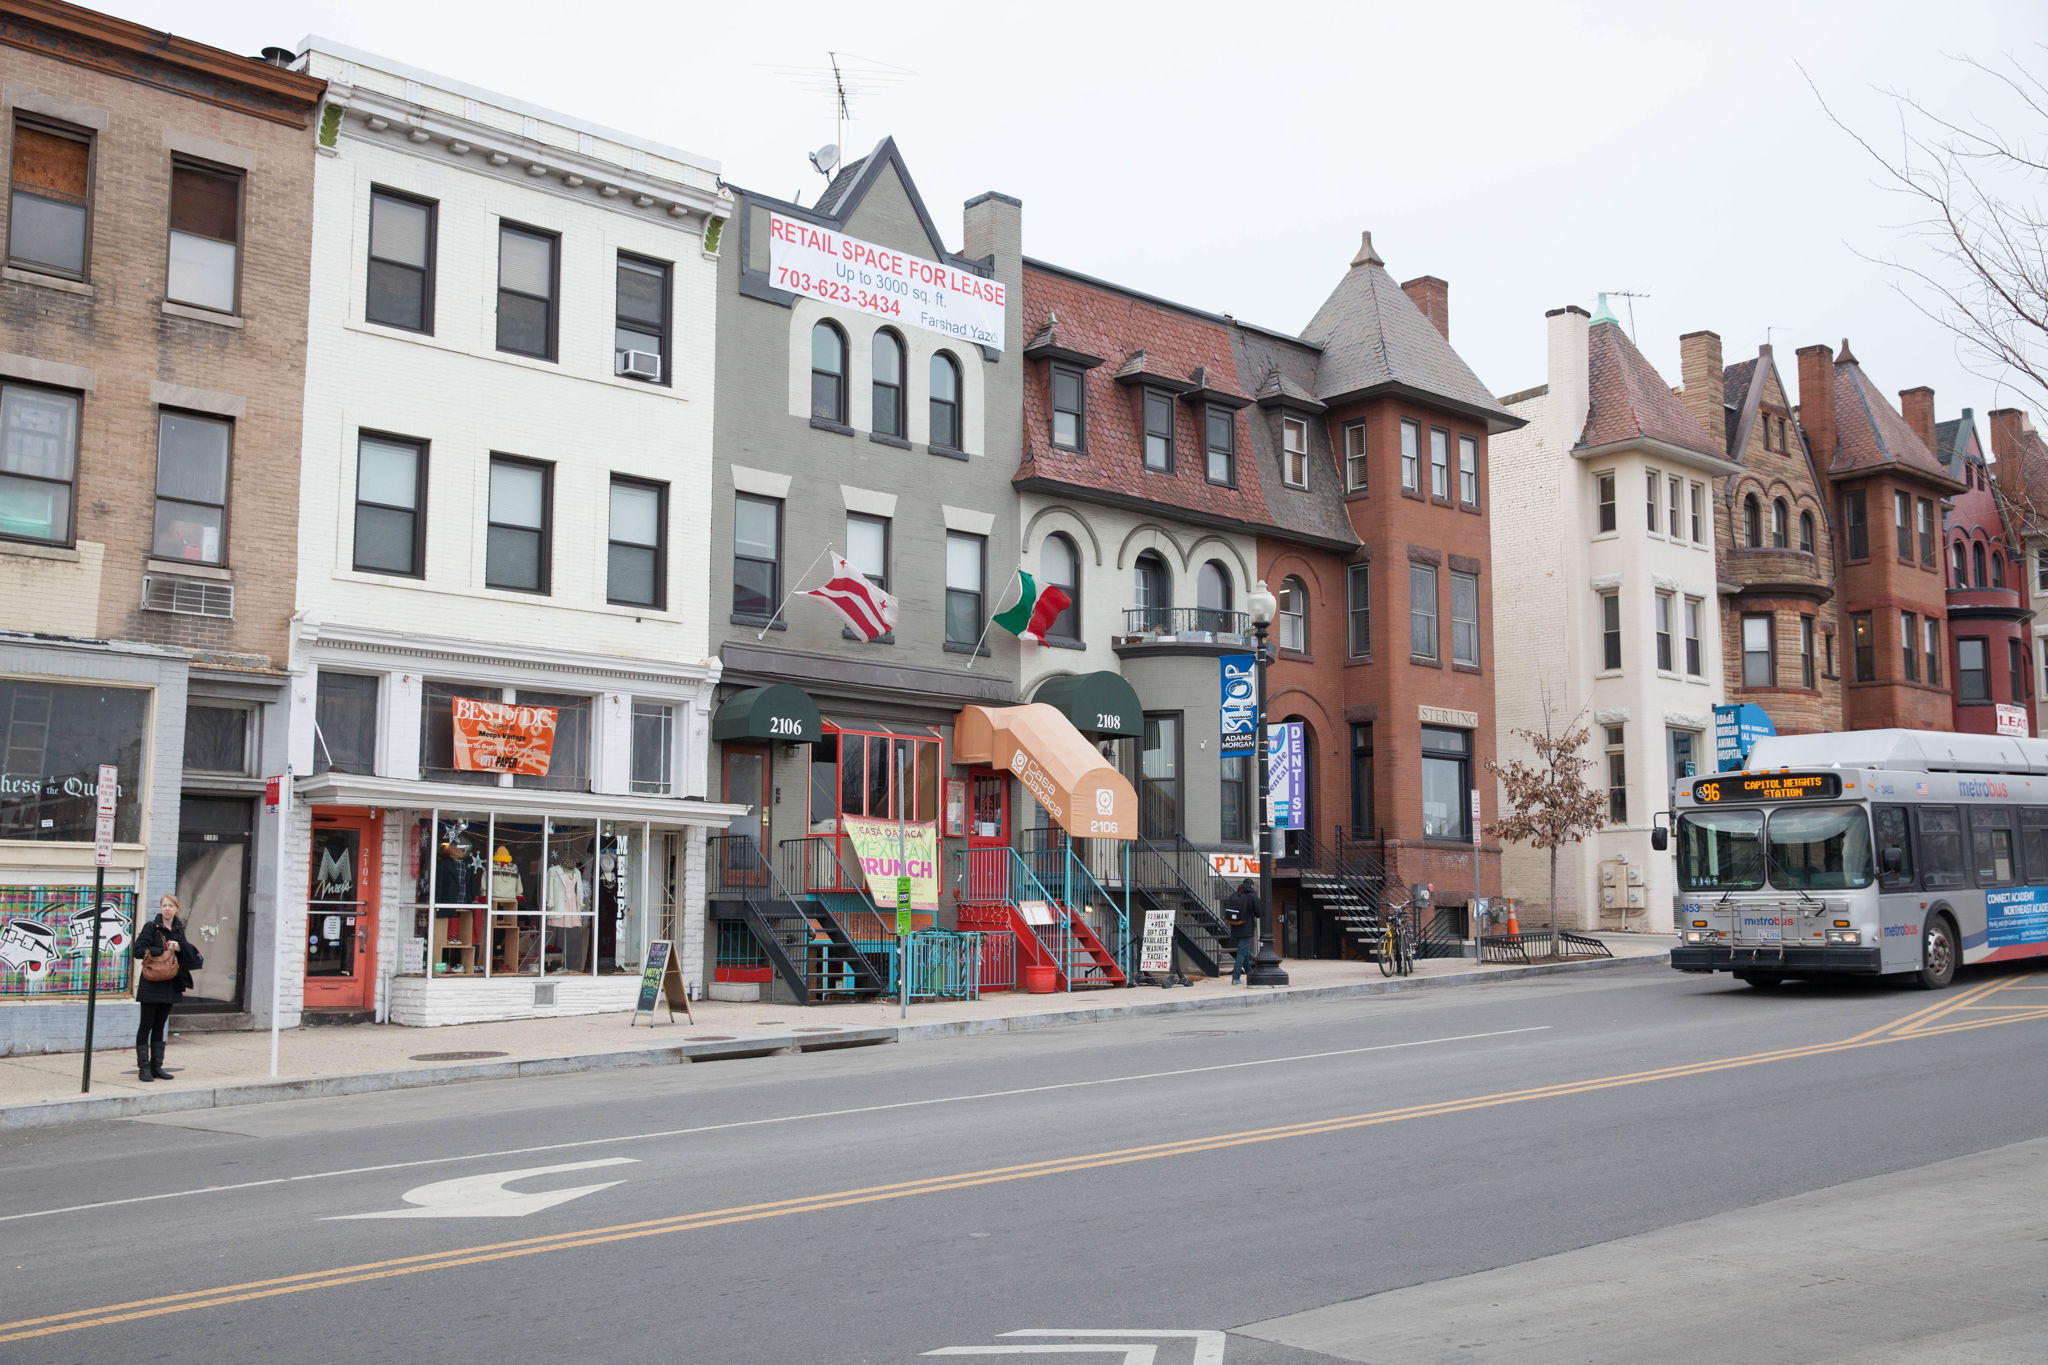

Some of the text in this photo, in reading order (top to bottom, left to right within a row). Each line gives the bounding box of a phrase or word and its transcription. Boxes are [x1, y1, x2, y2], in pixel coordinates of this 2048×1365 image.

[771, 218, 1005, 306] RETAIL SPACE FOR LEASE
[778, 266, 901, 316] 703-623-3434
[836, 262, 947, 308] Up to 3000 sq. ft.
[921, 311, 966, 336] Farshad
[1225, 664, 1253, 732] SHOP
[455, 699, 506, 723] BEST
[505, 706, 520, 725] of
[1096, 713, 1121, 729] 2108
[1421, 707, 1476, 726] STERLING
[770, 716, 802, 735] 2106
[1716, 725, 1739, 736] MORGAN
[478, 730, 526, 742] Meeps Vintage
[1222, 741, 1254, 749] MORGAN
[1225, 734, 1252, 742] ADAMS
[1717, 737, 1738, 748] ANIMAL
[1718, 748, 1743, 760] HOSPITAL
[1268, 751, 1288, 777] mile
[1027, 760, 1056, 795] Casa
[1268, 765, 1289, 792] ental
[1290, 726, 1302, 824] DENTIST
[46, 786, 59, 794] the
[64, 777, 123, 797] Qun
[1023, 770, 1062, 817] Oaxaca
[1702, 777, 1822, 801] 96 CAPITOL HEIGHTS
[1764, 787, 1803, 798] STATION
[1959, 778, 2008, 798] metrobus
[858, 826, 923, 839] CASA OAACA
[1090, 820, 1118, 833] 2106
[362, 848, 370, 886] 2104
[616, 835, 628, 940] MEEPS
[1987, 891, 2035, 904] CONNECT ACADEMY
[1681, 903, 1700, 913] 2453
[2003, 904, 2032, 916] NORTHEAST
[1744, 917, 1794, 926] metrobus
[1884, 923, 1918, 937] metrobus
